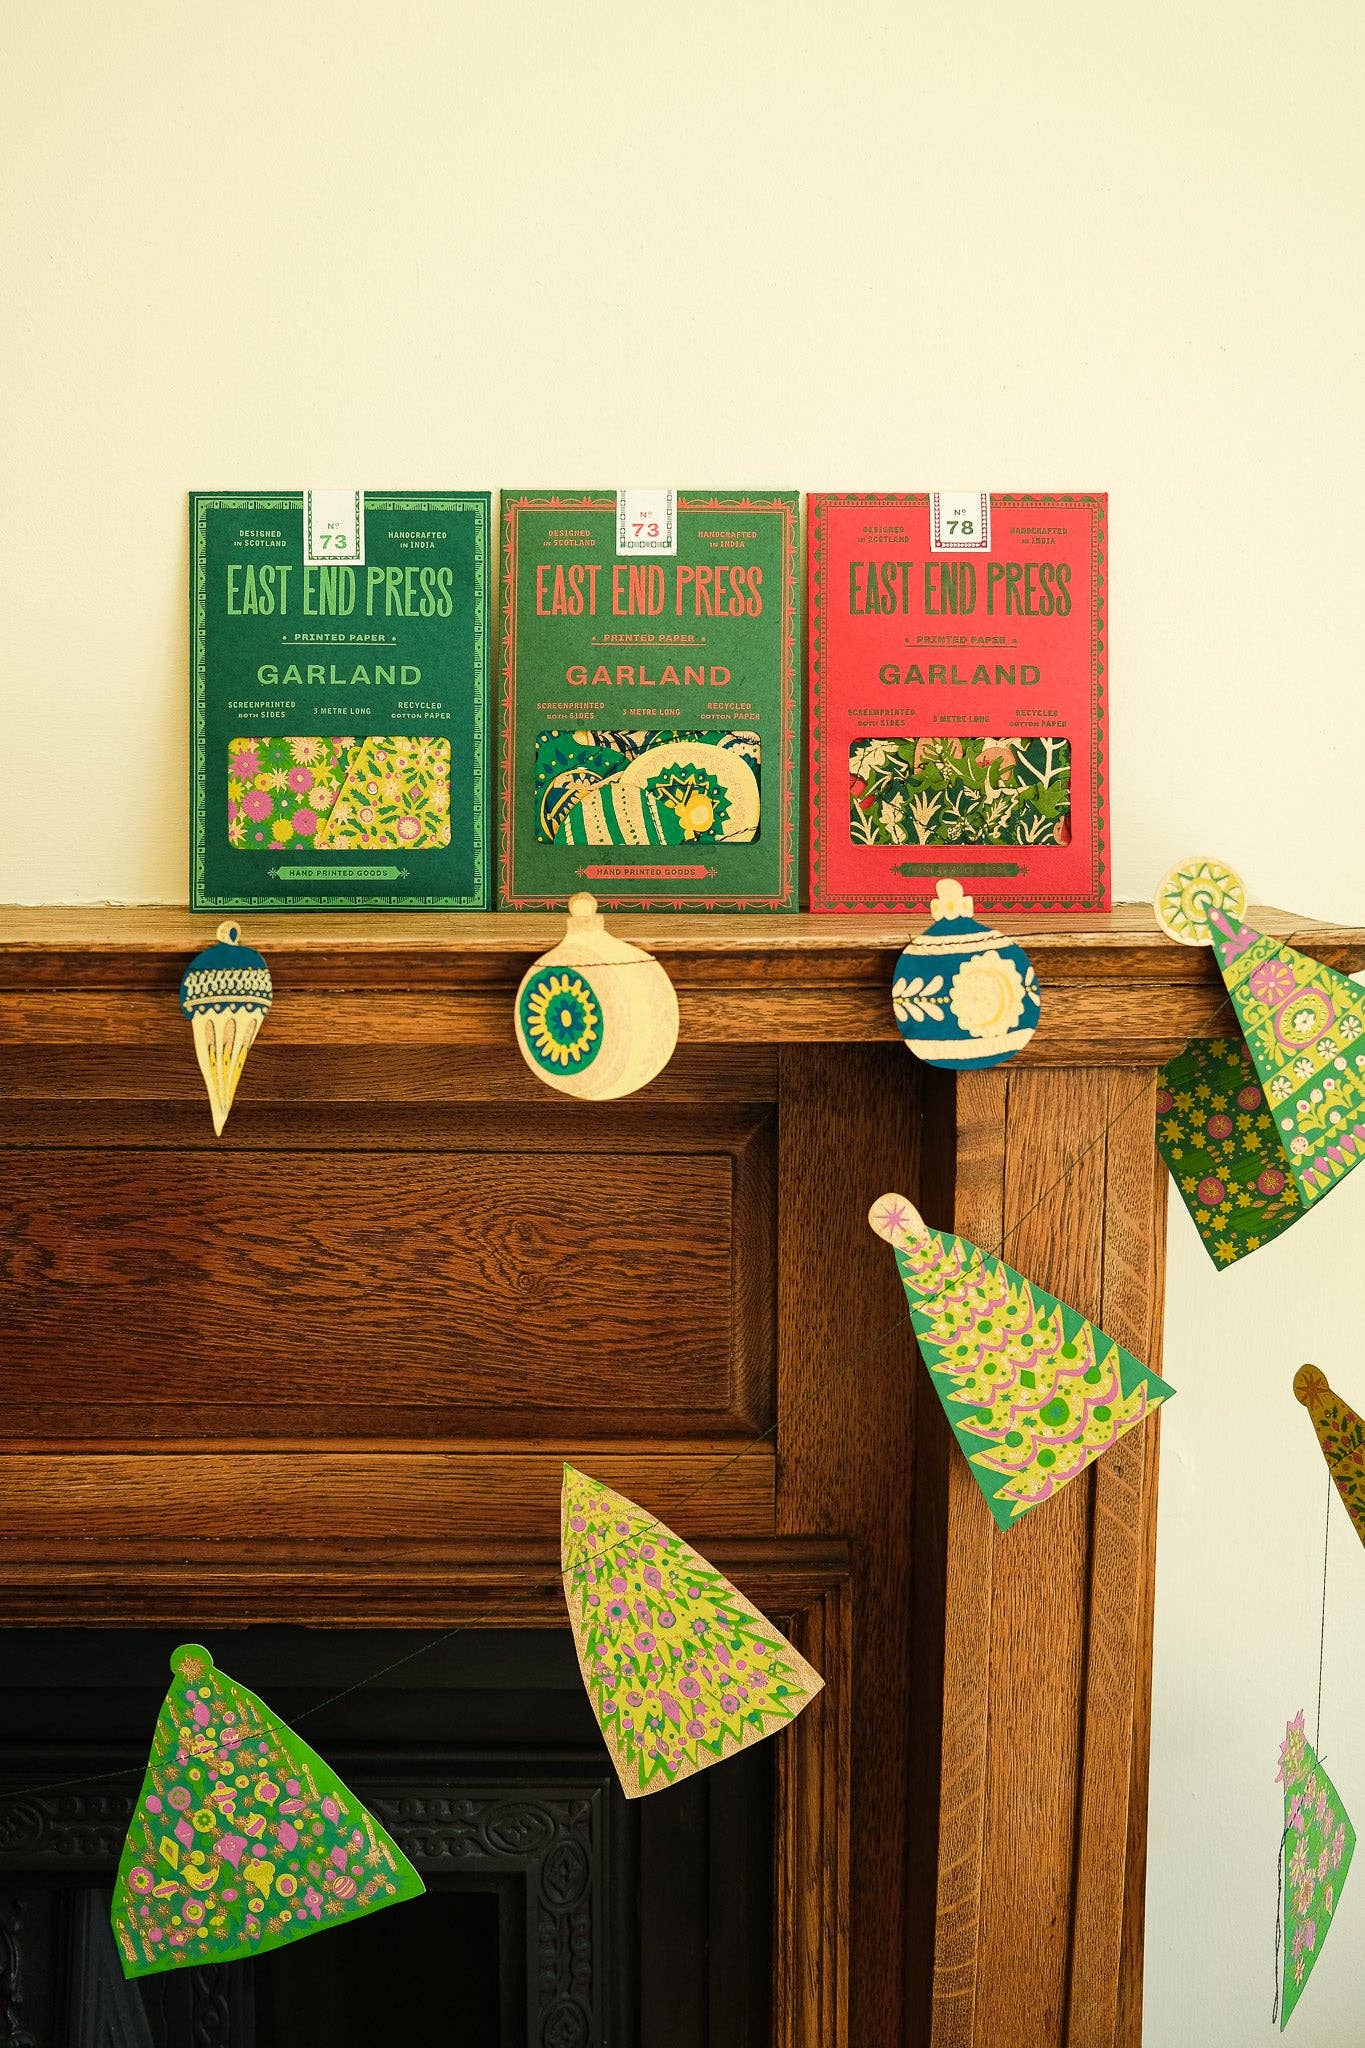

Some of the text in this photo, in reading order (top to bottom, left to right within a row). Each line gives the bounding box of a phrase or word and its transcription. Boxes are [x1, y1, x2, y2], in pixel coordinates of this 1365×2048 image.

[631, 523, 660, 537] 73
[946, 520, 974, 535] 78
[239, 530, 281, 538] DESIGNED
[388, 531, 447, 539] HANDCRAFTED
[697, 531, 757, 539] HANDCRAFTED
[244, 539, 287, 547] SCOTLAND
[319, 534, 348, 550] 73
[410, 541, 435, 549] INDIA
[553, 539, 596, 547] SCOTLAND
[719, 540, 745, 548] INDIA
[227, 564, 453, 617] EAST END PRESS
[536, 564, 763, 617] EAST END PRESS
[850, 561, 1072, 616] EAST END PRESS
[294, 633, 385, 642] PRINTED PAPER
[603, 634, 655, 642] PRINTED
[257, 664, 422, 686] GARLAND
[566, 665, 732, 687] GARLAND
[878, 664, 1041, 686] GARLAND
[228, 701, 296, 709] SCREENPRINTED
[536, 702, 605, 710] SCREENPRINTED
[313, 707, 318, 715] 3
[622, 708, 681, 716] 3 METRE LONG
[424, 712, 451, 720] PAPER
[569, 712, 595, 720] SIDES
